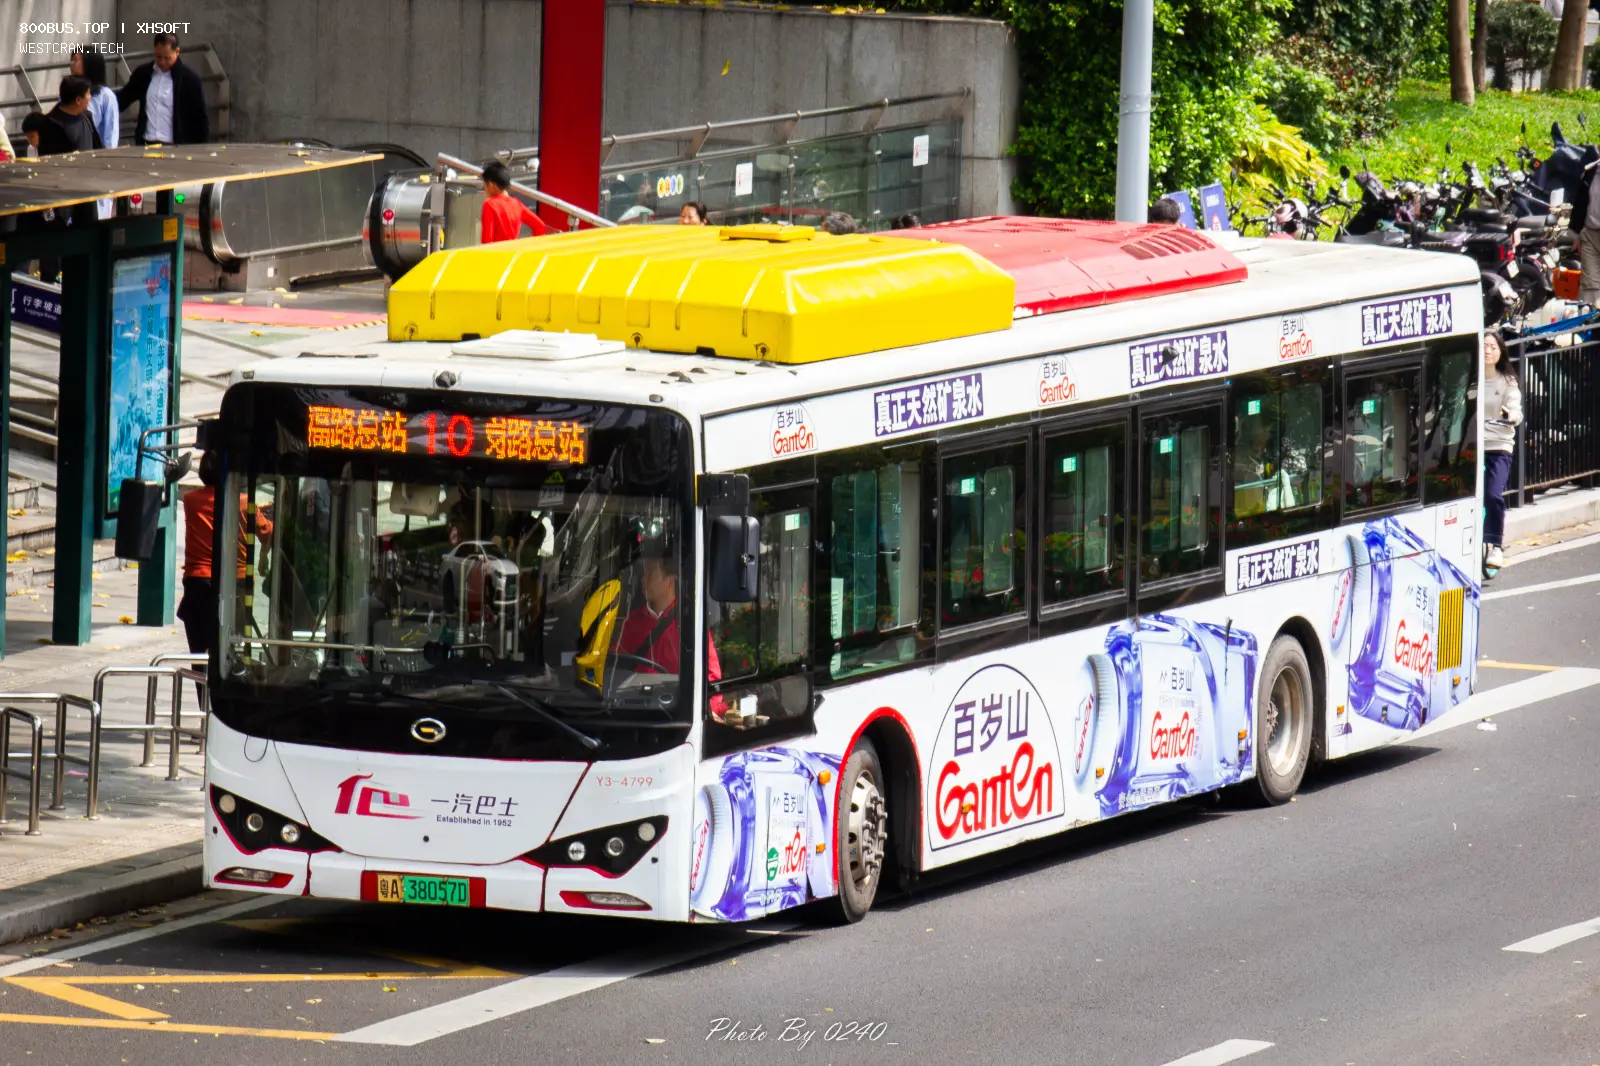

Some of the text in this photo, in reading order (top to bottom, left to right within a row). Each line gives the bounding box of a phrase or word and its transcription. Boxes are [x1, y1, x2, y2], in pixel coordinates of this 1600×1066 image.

[23, 295, 62, 315] 行李坡道
[1281, 317, 1304, 335] 百岁山
[1362, 294, 1452, 344] 真正天然矿泉水
[1279, 332, 1314, 360] Ganten
[1043, 359, 1067, 379] 百岁山
[1039, 376, 1077, 403] Ganten
[875, 375, 983, 434] 真正天然矿泉水
[776, 409, 804, 429] 百岁山
[421, 412, 475, 456] 10
[772, 425, 815, 455] Ganten
[1238, 540, 1319, 590] 真正天然矿泉水
[1394, 619, 1433, 677] Ganten
[1171, 666, 1193, 692] 百岁山
[953, 688, 1030, 758] 百岁山
[1150, 710, 1195, 761] Ganten
[596, 775, 654, 789] Y3-4799
[935, 741, 1053, 840] Ganten
[430, 792, 519, 818] 一汽巴士
[783, 792, 804, 814] 百岁山
[436, 814, 481, 826] Established
[493, 818, 512, 828] 1952
[380, 878, 467, 903] 粤A 38057D
